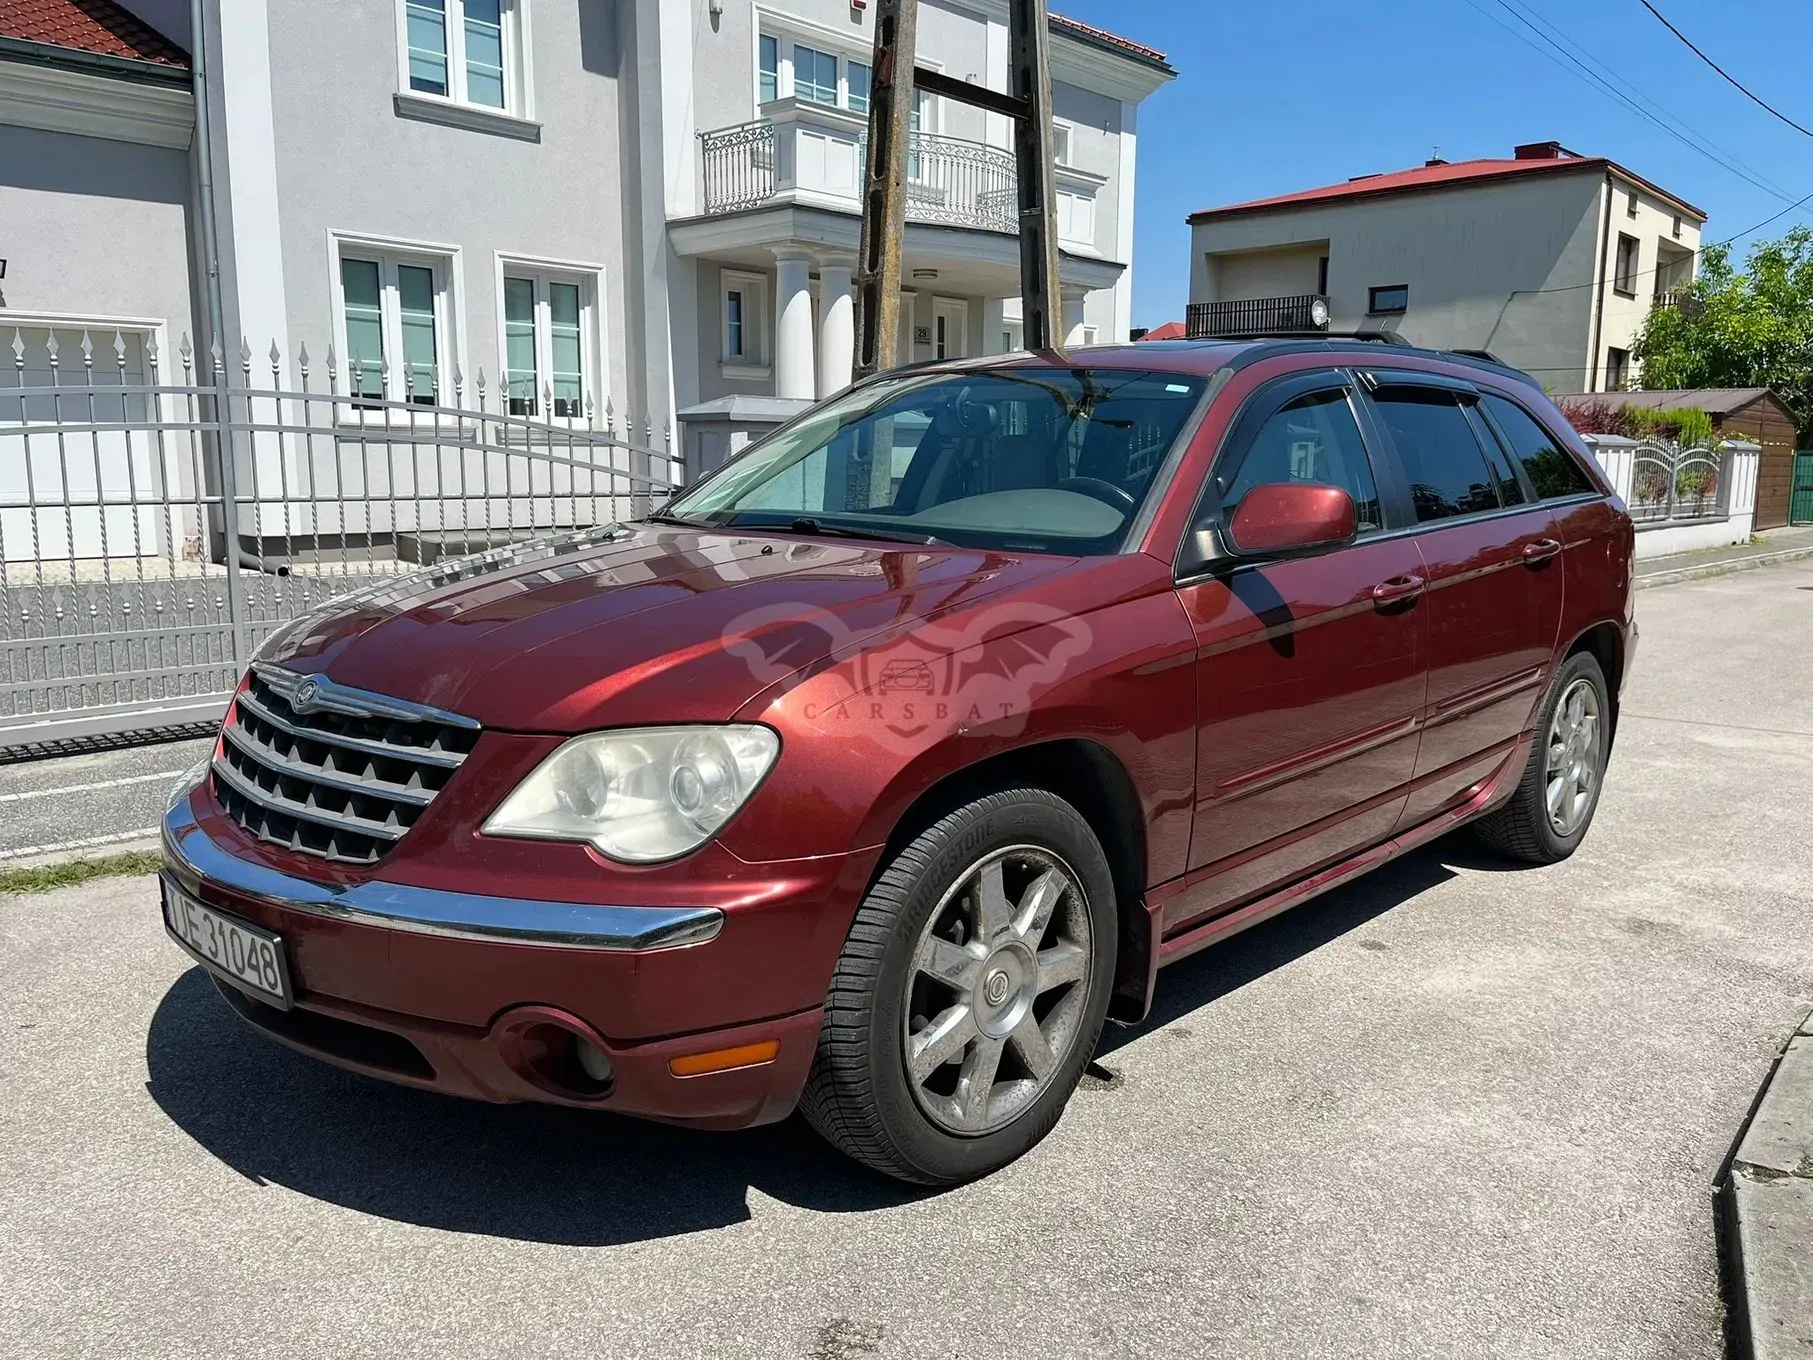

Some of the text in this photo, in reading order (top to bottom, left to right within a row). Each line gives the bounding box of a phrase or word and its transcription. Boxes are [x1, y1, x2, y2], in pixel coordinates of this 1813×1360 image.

[918, 328, 927, 338] 29
[167, 885, 278, 990] TJE 31048
